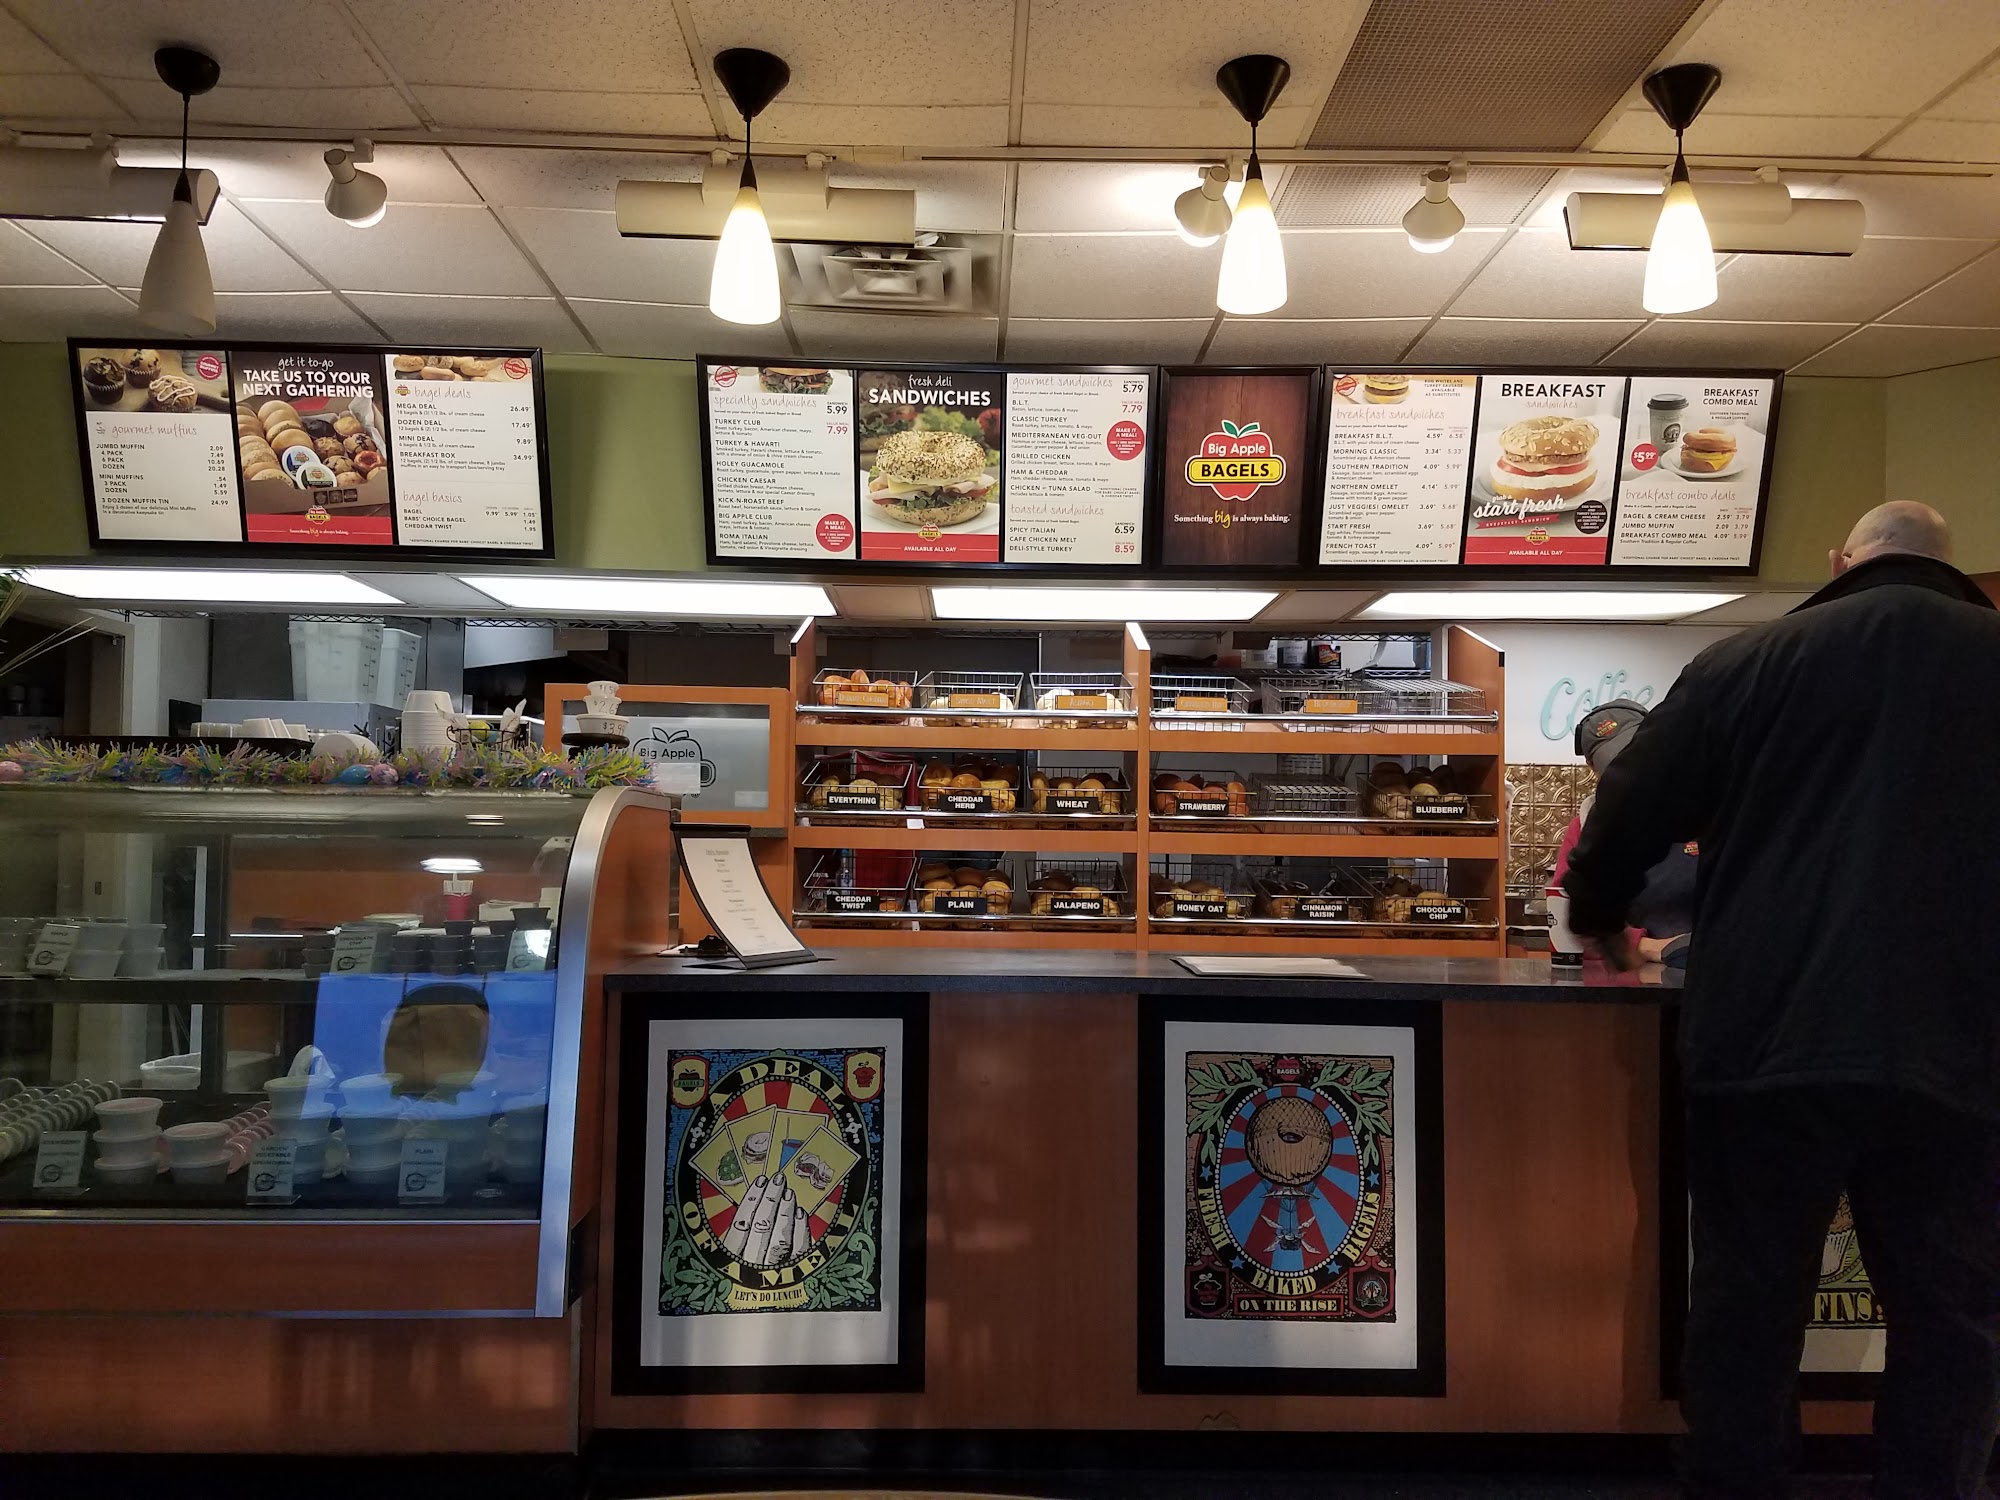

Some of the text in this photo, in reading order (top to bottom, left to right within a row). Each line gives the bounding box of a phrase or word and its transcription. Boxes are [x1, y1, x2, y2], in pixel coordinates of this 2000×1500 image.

[278, 357, 294, 371] get
[298, 357, 305, 367] it
[243, 370, 370, 384] TAKE US TO YOUR
[908, 374, 952, 389] fresh deli
[243, 383, 374, 398] NEXT GATHERING
[1013, 376, 1144, 393] gourmet sandwiches 5.79
[1501, 383, 1606, 398] BREAKFAST
[415, 388, 472, 402] bagel deals
[869, 389, 991, 407] SANDWICHES
[1704, 388, 1759, 397] BREAKFAST
[714, 395, 817, 410] specialty sandwiches
[1122, 404, 1143, 413] 7.79
[1526, 399, 1578, 409] sandwiches
[827, 406, 847, 414] 5.99
[1336, 408, 1445, 422] breakfast sandwiches
[112, 425, 197, 438] gourmet muffins
[827, 426, 848, 434] 7.99
[1208, 443, 1266, 457] Big Apple
[1201, 464, 1270, 477] BAGELS
[403, 491, 463, 506] bagel basics
[1626, 489, 1736, 502] breakfast combo deals
[1011, 504, 1104, 516] toasted sandwiches
[1473, 502, 1516, 519] start
[1518, 494, 1566, 520] fresh
[1174, 514, 1213, 524] Something
[1215, 510, 1231, 529] big
[1240, 515, 1263, 524] always
[1114, 526, 1135, 534] 6.59
[1115, 545, 1135, 553] 8.59
[640, 747, 696, 759] Big Apple
[829, 796, 876, 804] EVERYTHING
[1056, 800, 1088, 808] WHEAT
[1179, 803, 1226, 811] STRAWBERRY
[1415, 806, 1464, 814] BLUEBERRY
[948, 901, 974, 909] PLAIN
[1054, 901, 1100, 910] JALAPENO
[1176, 904, 1224, 913] HONEY OAT
[1429, 912, 1448, 920] CHIP
[1197, 1186, 1231, 1250] FRESH
[1250, 1269, 1317, 1296] BAKED
[1342, 1191, 1381, 1263] BAGELS
[734, 1289, 803, 1302] LET'S DO LUNCH!
[1240, 1299, 1337, 1312] ON THE RISE
